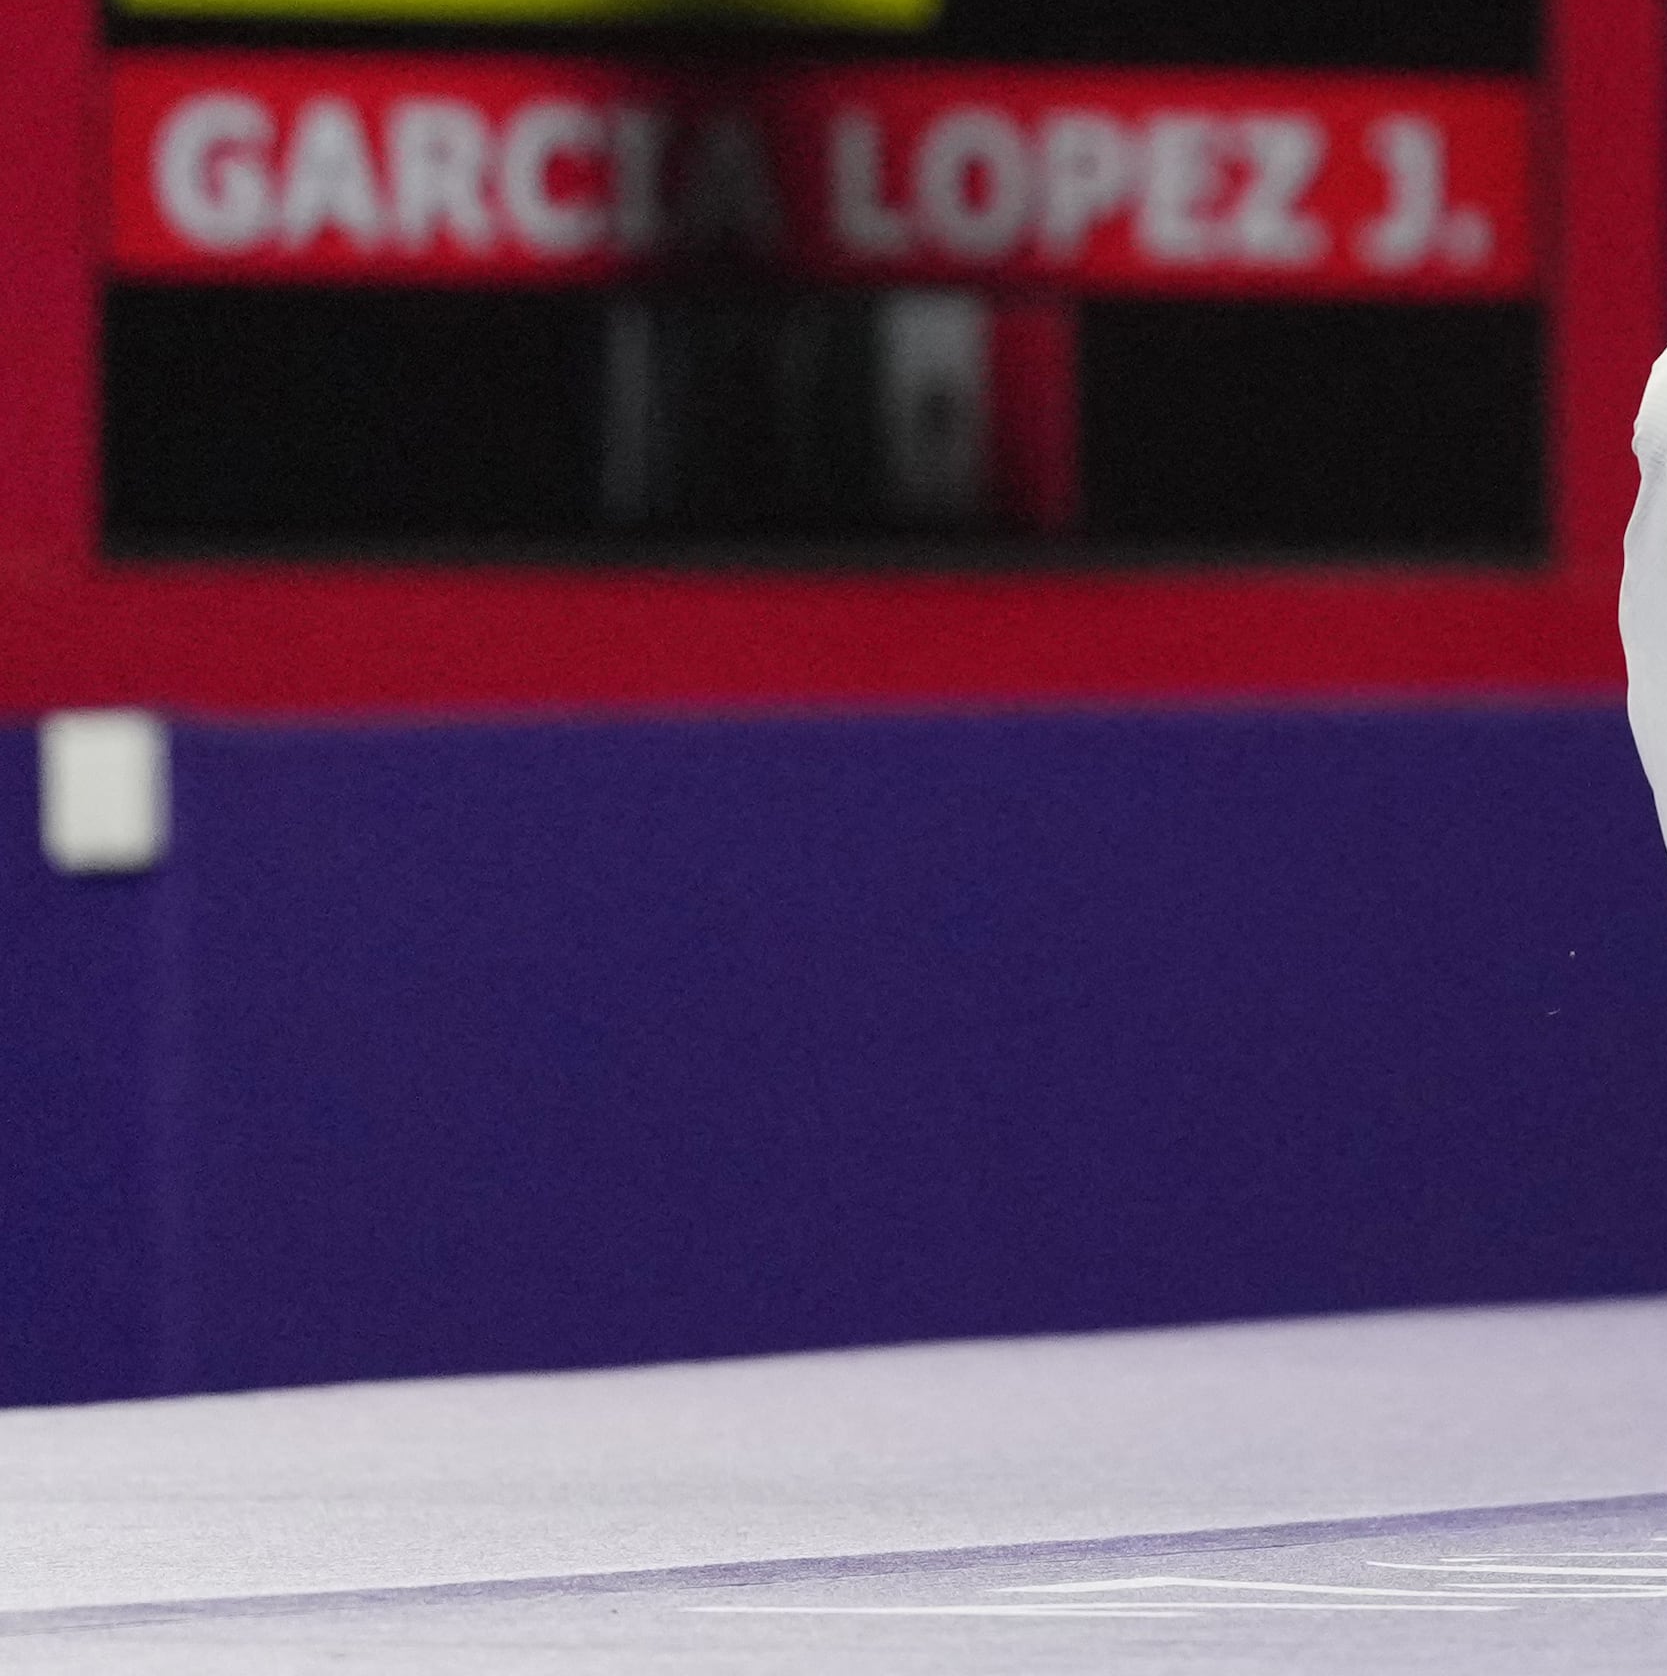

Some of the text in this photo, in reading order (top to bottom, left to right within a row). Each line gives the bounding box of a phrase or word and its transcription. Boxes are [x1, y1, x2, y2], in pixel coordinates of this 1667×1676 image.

[151, 90, 1495, 274] GARCIA LOPEZ J.
